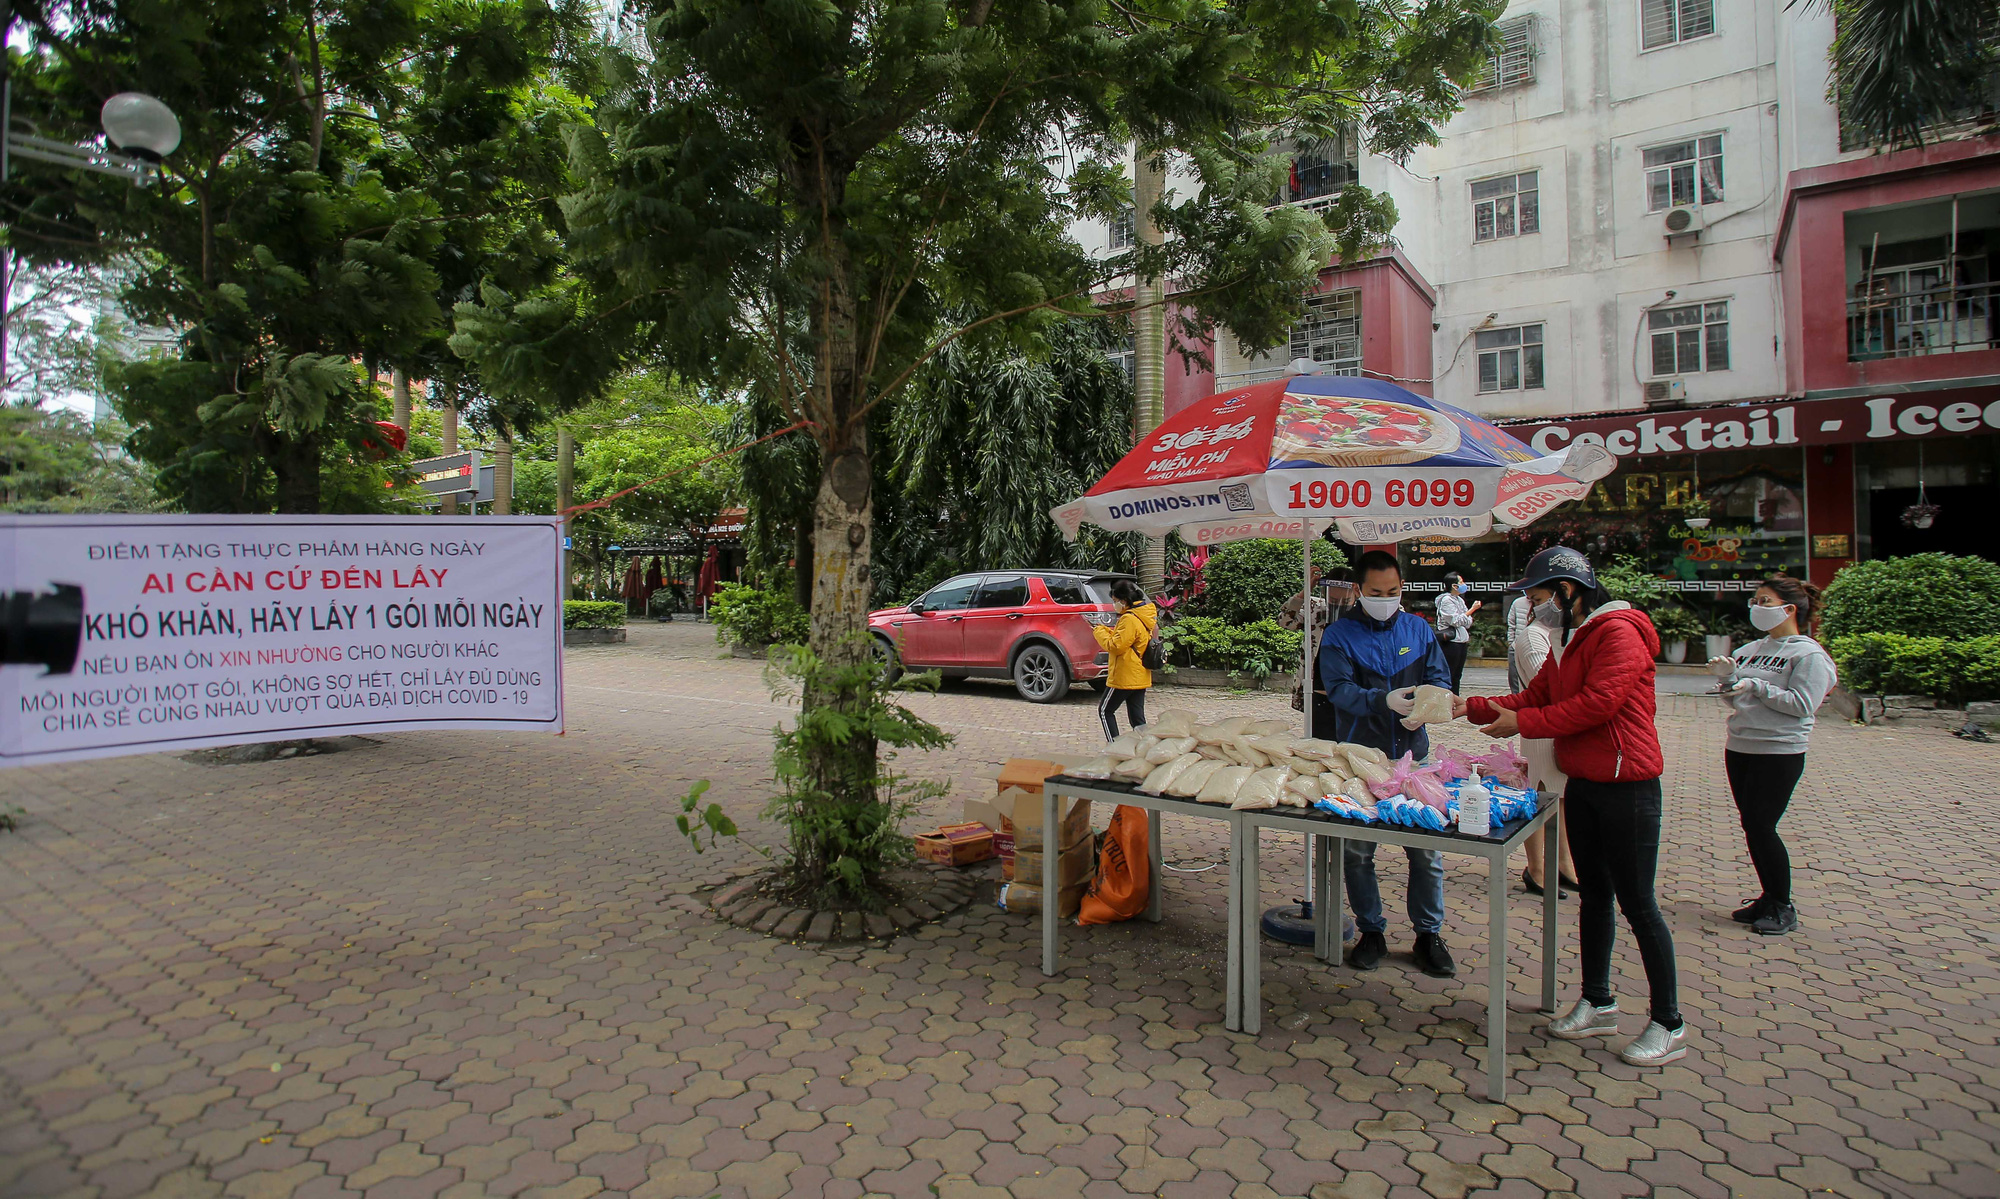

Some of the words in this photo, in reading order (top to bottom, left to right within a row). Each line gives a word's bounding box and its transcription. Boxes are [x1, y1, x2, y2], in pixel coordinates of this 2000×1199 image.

[1195, 446, 1234, 467] PHÍ
[1109, 493, 1222, 519] DOMINOS.VN
[1288, 480, 1372, 509] 1900
[1384, 479, 1475, 508] 6099
[1553, 471, 1698, 512] AFE
[227, 543, 291, 560] THỰC
[431, 540, 486, 556] NGÀY
[1420, 544, 1461, 554] Espresso
[142, 572, 174, 594] AI
[185, 566, 254, 593] CẦN
[265, 565, 312, 591] CỨ
[320, 564, 382, 590] ĐẾN
[393, 564, 448, 589] LẤY
[86, 604, 149, 641] KHÓ
[158, 602, 243, 639] KHĂN,
[251, 601, 303, 633] HÃY
[311, 599, 358, 631] LẤY
[366, 604, 376, 629] 1
[385, 597, 427, 629] GÓI
[435, 597, 476, 628] MỖI
[483, 597, 543, 628] NGÀY
[136, 654, 177, 674] BẠN
[219, 651, 251, 667] XIN
[257, 644, 342, 665] NHƯỜNG
[348, 645, 386, 660] CHO
[391, 640, 450, 659] NGƯỜI
[455, 640, 499, 657] KHÁC
[72, 684, 147, 708] NGƯỜI
[155, 682, 199, 703] MỘT
[206, 678, 246, 697] GÓI,
[252, 674, 320, 694] KHÔNG
[326, 674, 353, 691] SỢ
[401, 668, 429, 686] CHỈ
[434, 668, 465, 686] LẤY
[469, 668, 491, 685] ĐỦ
[497, 668, 541, 686] DÙNG
[43, 712, 98, 733] CHIA
[138, 703, 199, 724] CÙNG
[206, 700, 259, 718] NHAU
[265, 696, 321, 714] VƯỢT
[326, 693, 365, 709] QUA
[369, 691, 397, 708] ĐẠI
[402, 690, 442, 707] DỊCH
[448, 689, 498, 704] COVID
[512, 690, 528, 704] 19
